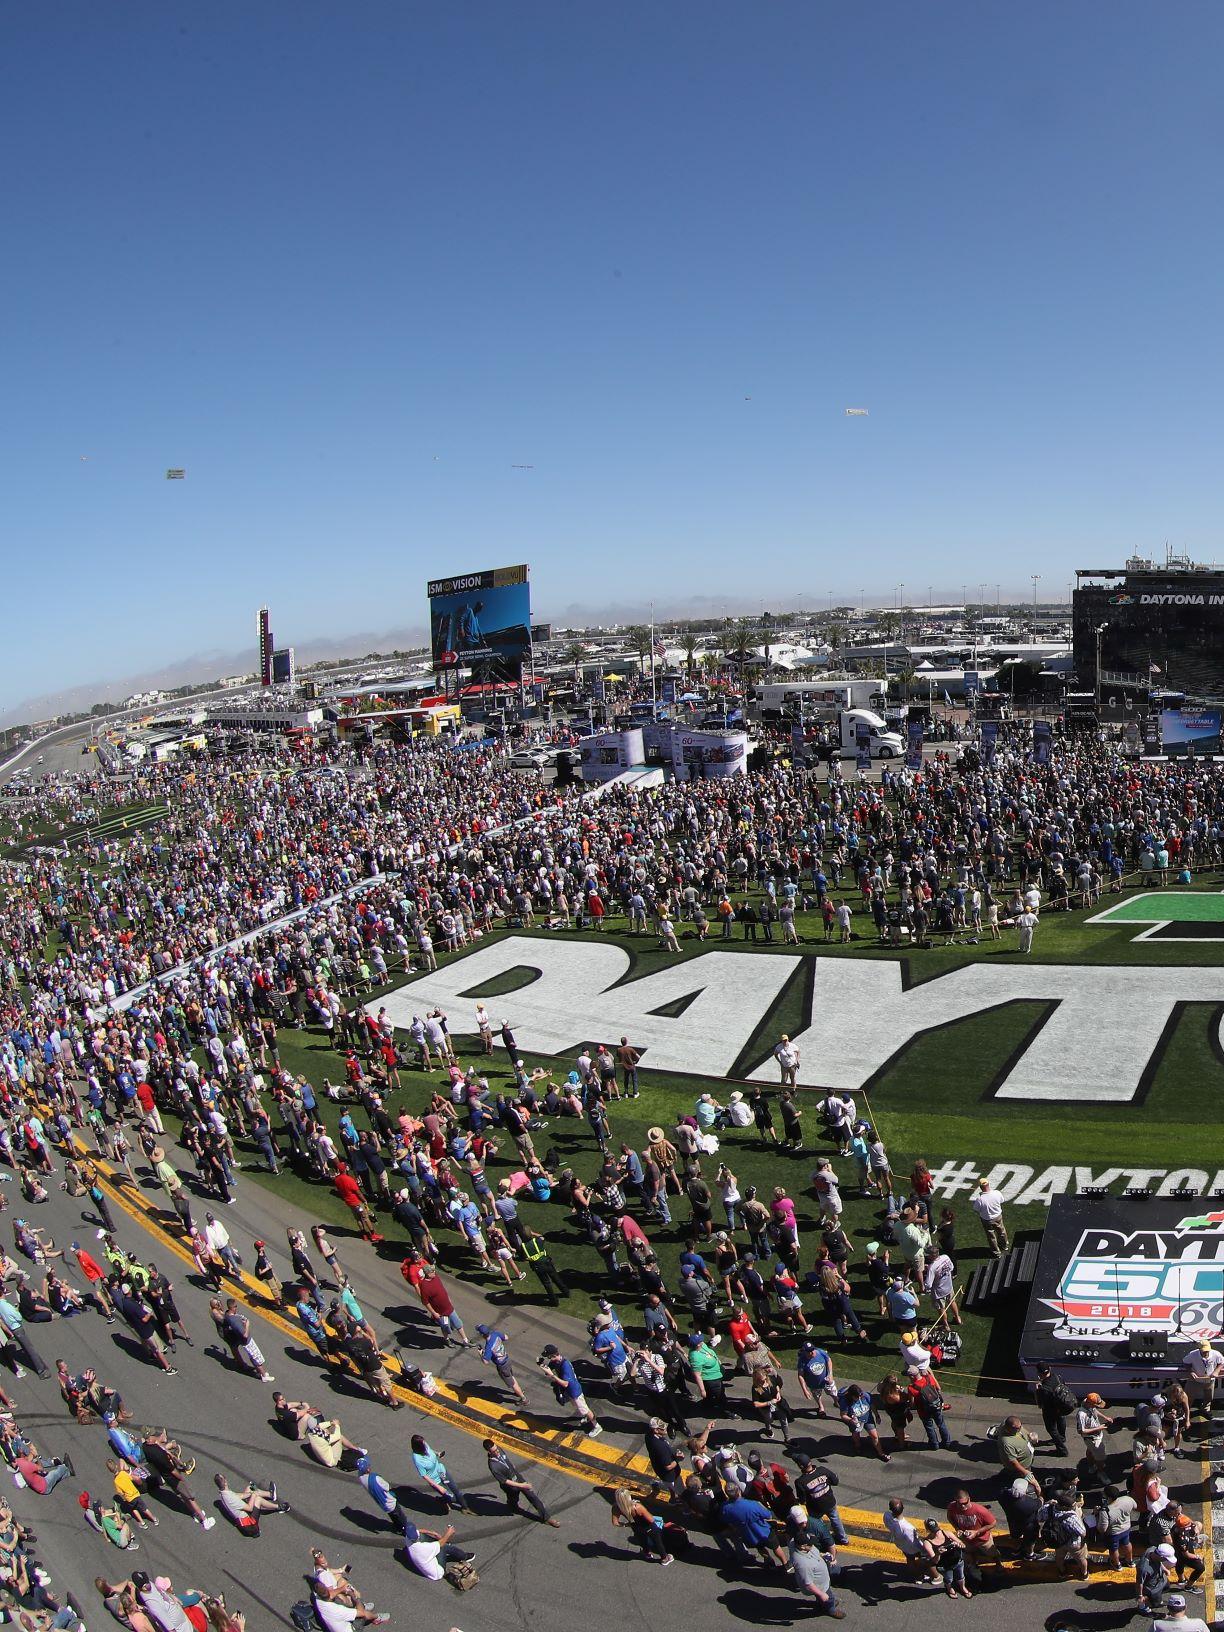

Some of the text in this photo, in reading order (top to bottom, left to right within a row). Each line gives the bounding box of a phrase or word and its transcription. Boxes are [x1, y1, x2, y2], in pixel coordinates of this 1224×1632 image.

[429, 576, 482, 594] ISM VISION
[1140, 594, 1205, 605] DAYTONA
[1091, 1305, 1152, 1317] 2018
[1067, 1327, 1101, 1336] THE
